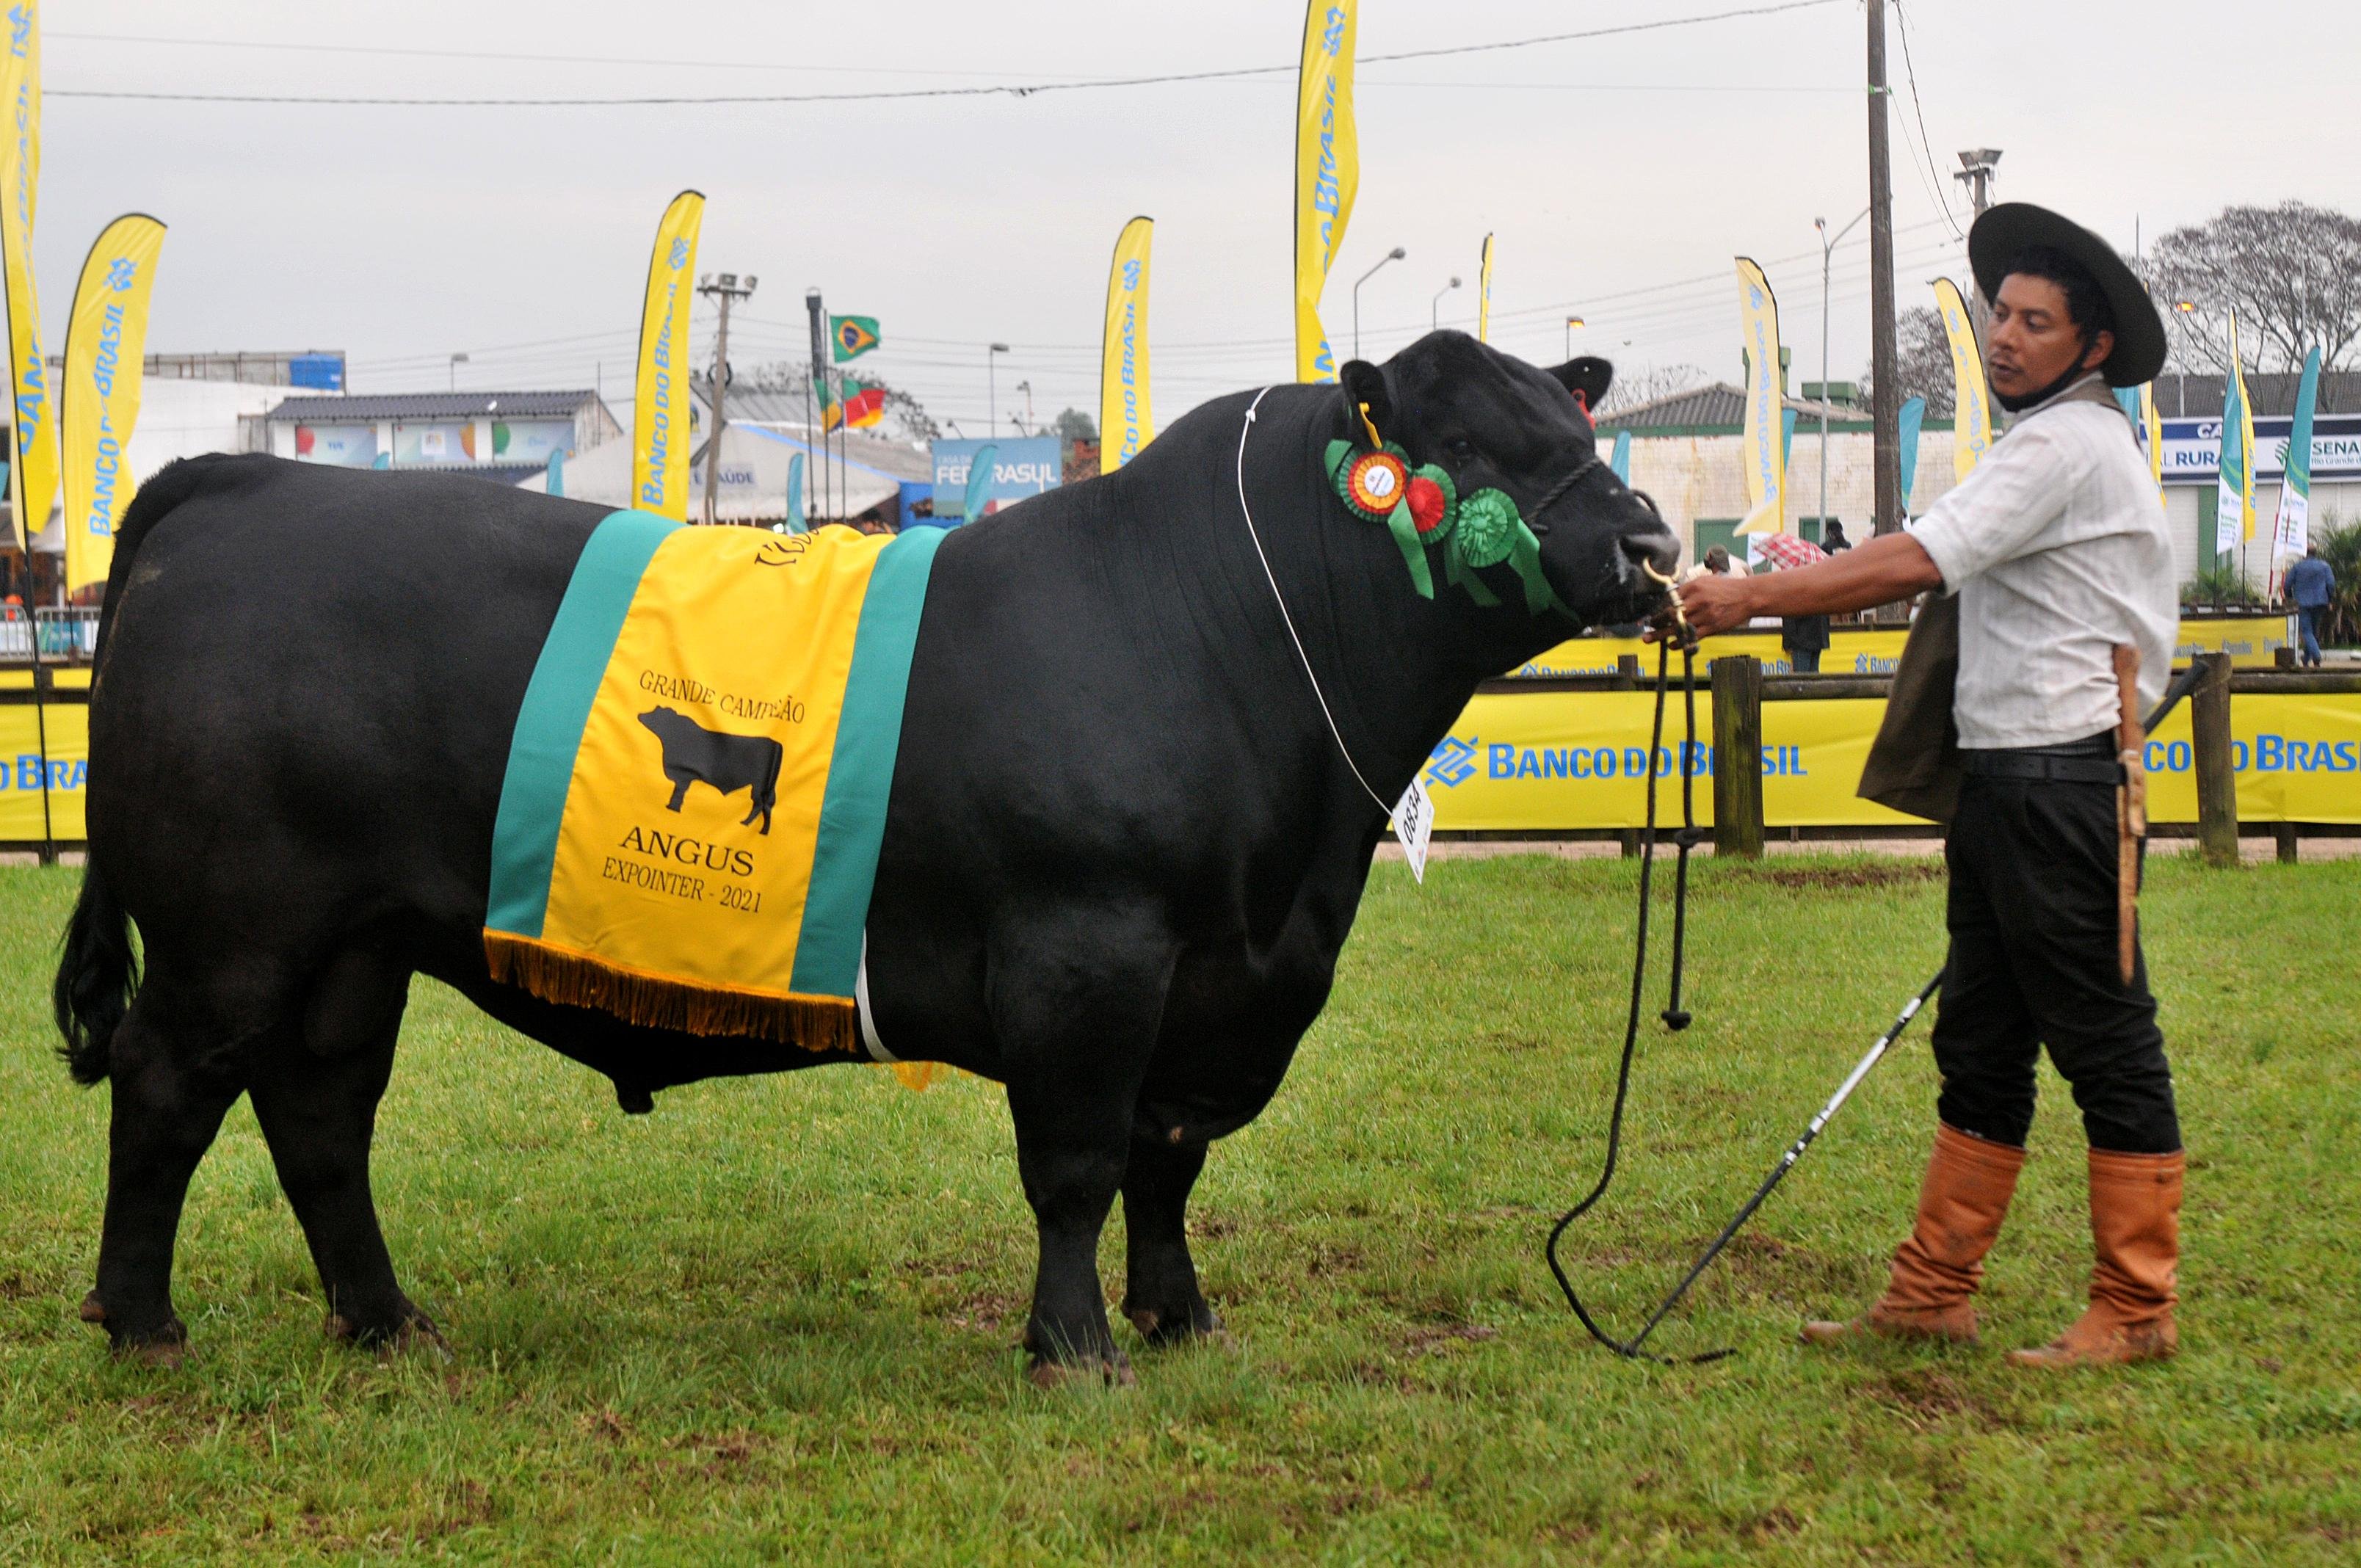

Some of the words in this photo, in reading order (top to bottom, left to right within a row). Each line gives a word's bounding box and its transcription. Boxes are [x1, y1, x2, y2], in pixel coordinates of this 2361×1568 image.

[1314, 75, 1341, 219] BRASIL
[93, 302, 126, 401] BRASIL
[1121, 301, 1136, 387] BRASIL
[655, 371, 670, 410] DO
[1124, 390, 1138, 425] DO
[88, 438, 120, 539] BANCO
[642, 412, 669, 507] BANCO
[639, 669, 716, 705] GRANDE
[720, 693, 805, 725] CAMPEÃO
[1488, 743, 1617, 780] BANCO
[1624, 747, 1672, 778] DO
[1679, 740, 1808, 777] BSIL
[1403, 781, 1422, 845] 0834
[617, 826, 755, 877] ANGUS
[602, 857, 703, 901] EXPOINTER
[720, 885, 762, 915] 2021
